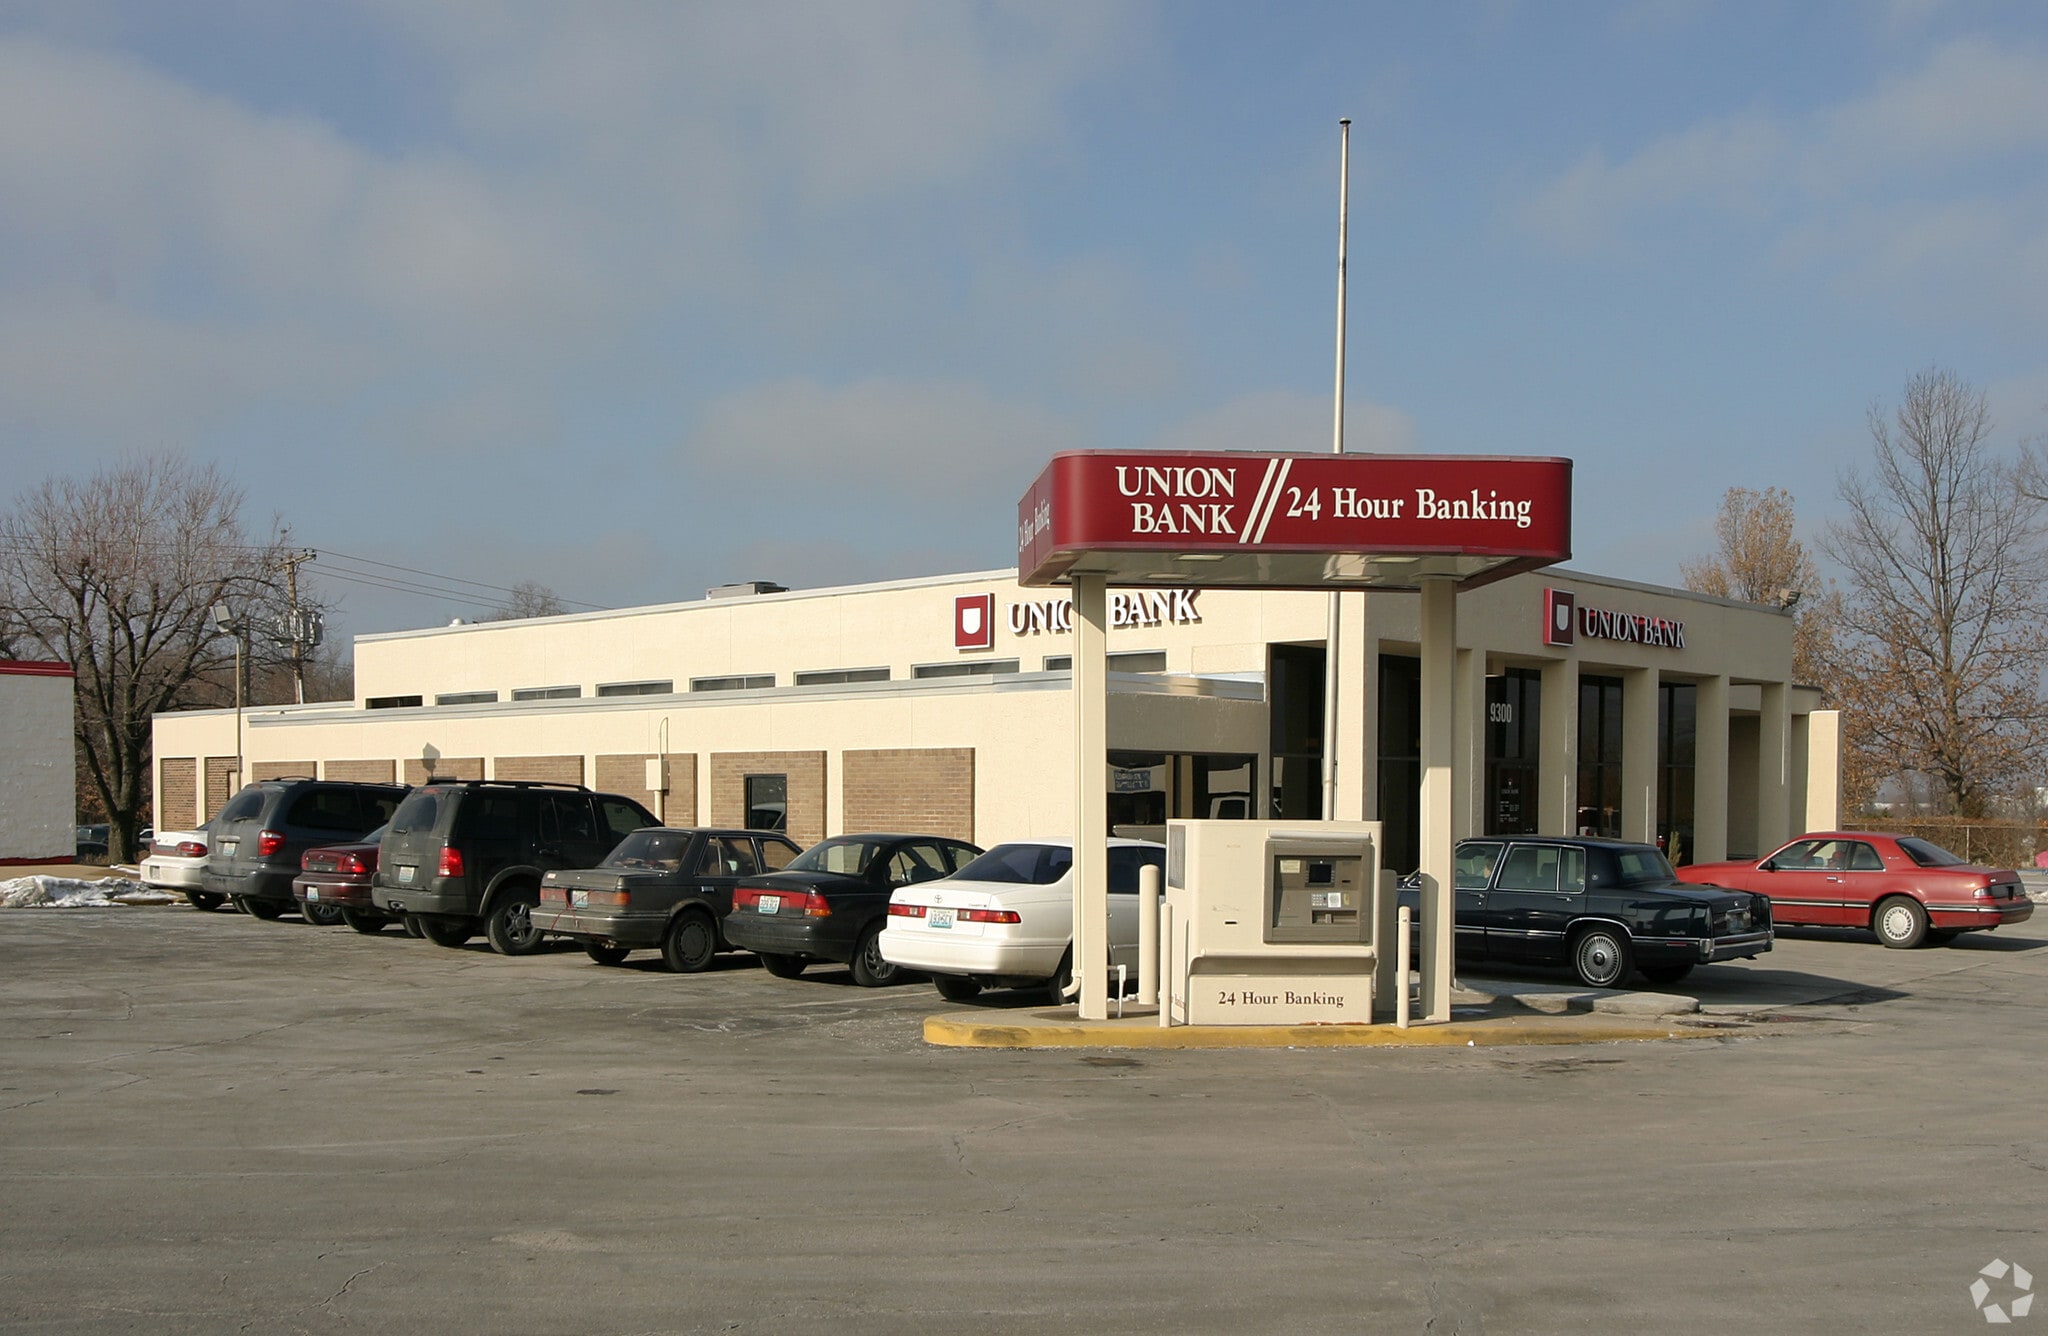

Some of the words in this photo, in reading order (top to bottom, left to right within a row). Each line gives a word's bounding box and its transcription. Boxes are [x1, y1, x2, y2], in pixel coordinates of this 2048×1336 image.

[1115, 466, 1237, 498] UNION
[1131, 502, 1237, 535] BANK
[1286, 486, 1322, 521] 24
[1332, 487, 1405, 519] Hour
[1415, 488, 1532, 529] Banking
[1006, 599, 1073, 635] UNIO
[1108, 588, 1201, 627] BANK
[1580, 607, 1640, 642] UNION
[1643, 615, 1687, 649] BANK
[1490, 702, 1512, 723] 9300
[1218, 991, 1236, 1006] 24
[1242, 991, 1279, 1005] Hour
[1285, 991, 1345, 1009] Banking
